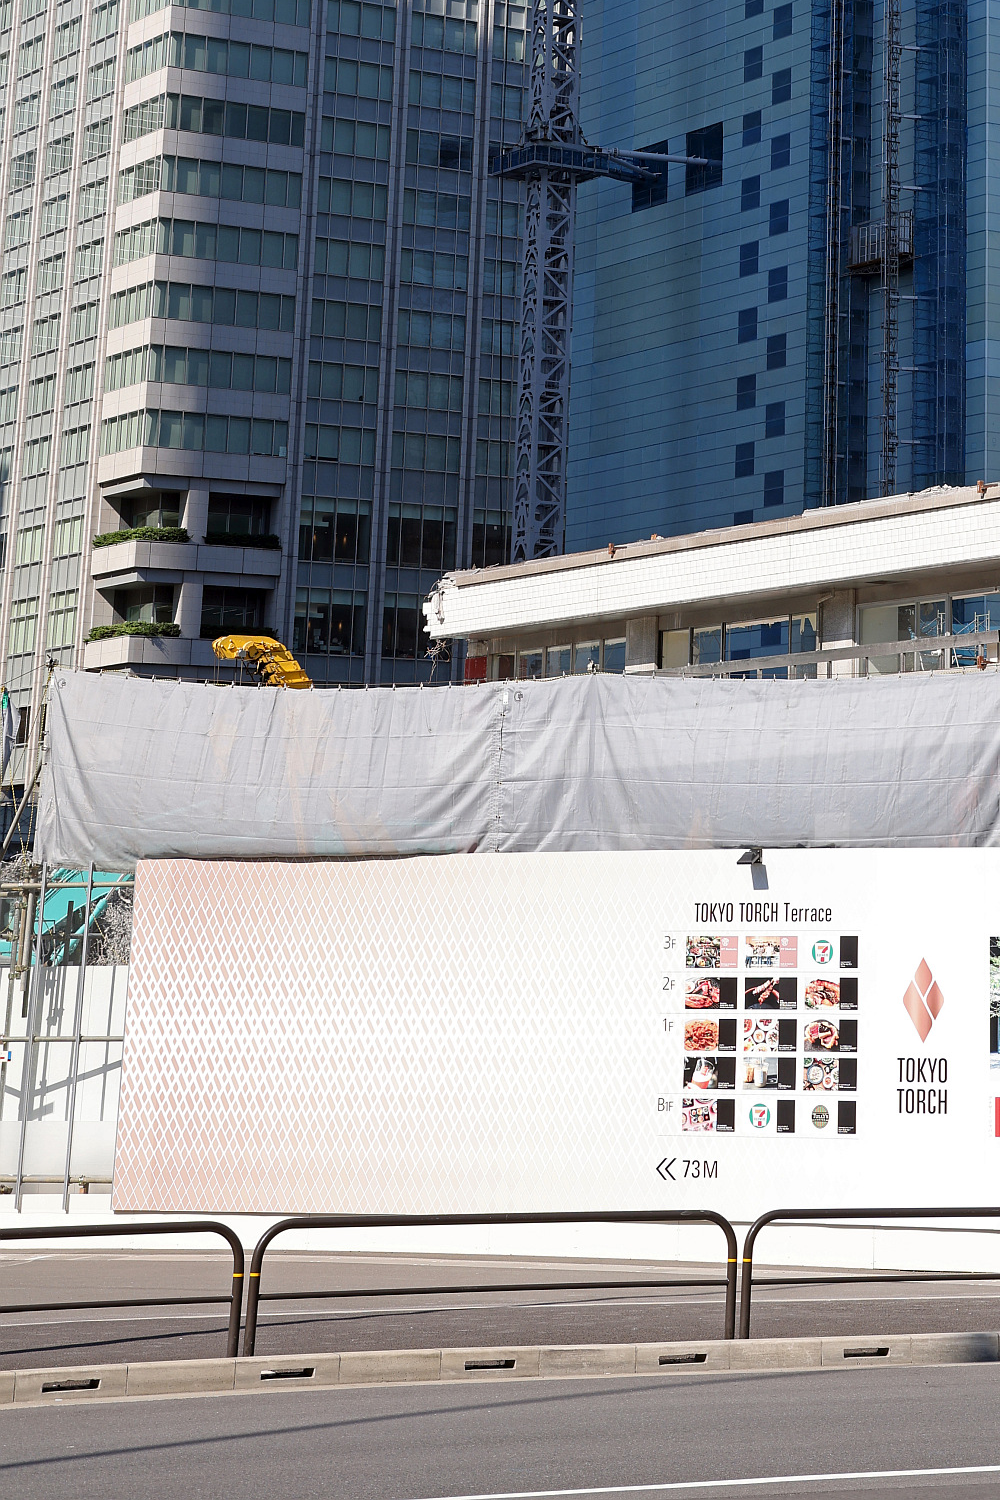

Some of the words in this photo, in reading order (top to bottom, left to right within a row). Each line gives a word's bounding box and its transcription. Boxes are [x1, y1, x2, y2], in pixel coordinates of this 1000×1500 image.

[695, 902, 733, 922] TOKYO
[739, 902, 778, 922] TORCH
[784, 902, 832, 922] Terrace
[663, 935, 676, 950] 3F
[662, 977, 676, 991] 2F
[662, 1018, 674, 1032] 1F
[897, 1057, 948, 1083] TOKYO
[657, 1097, 674, 1112] B1F
[897, 1088, 948, 1114] TORCH
